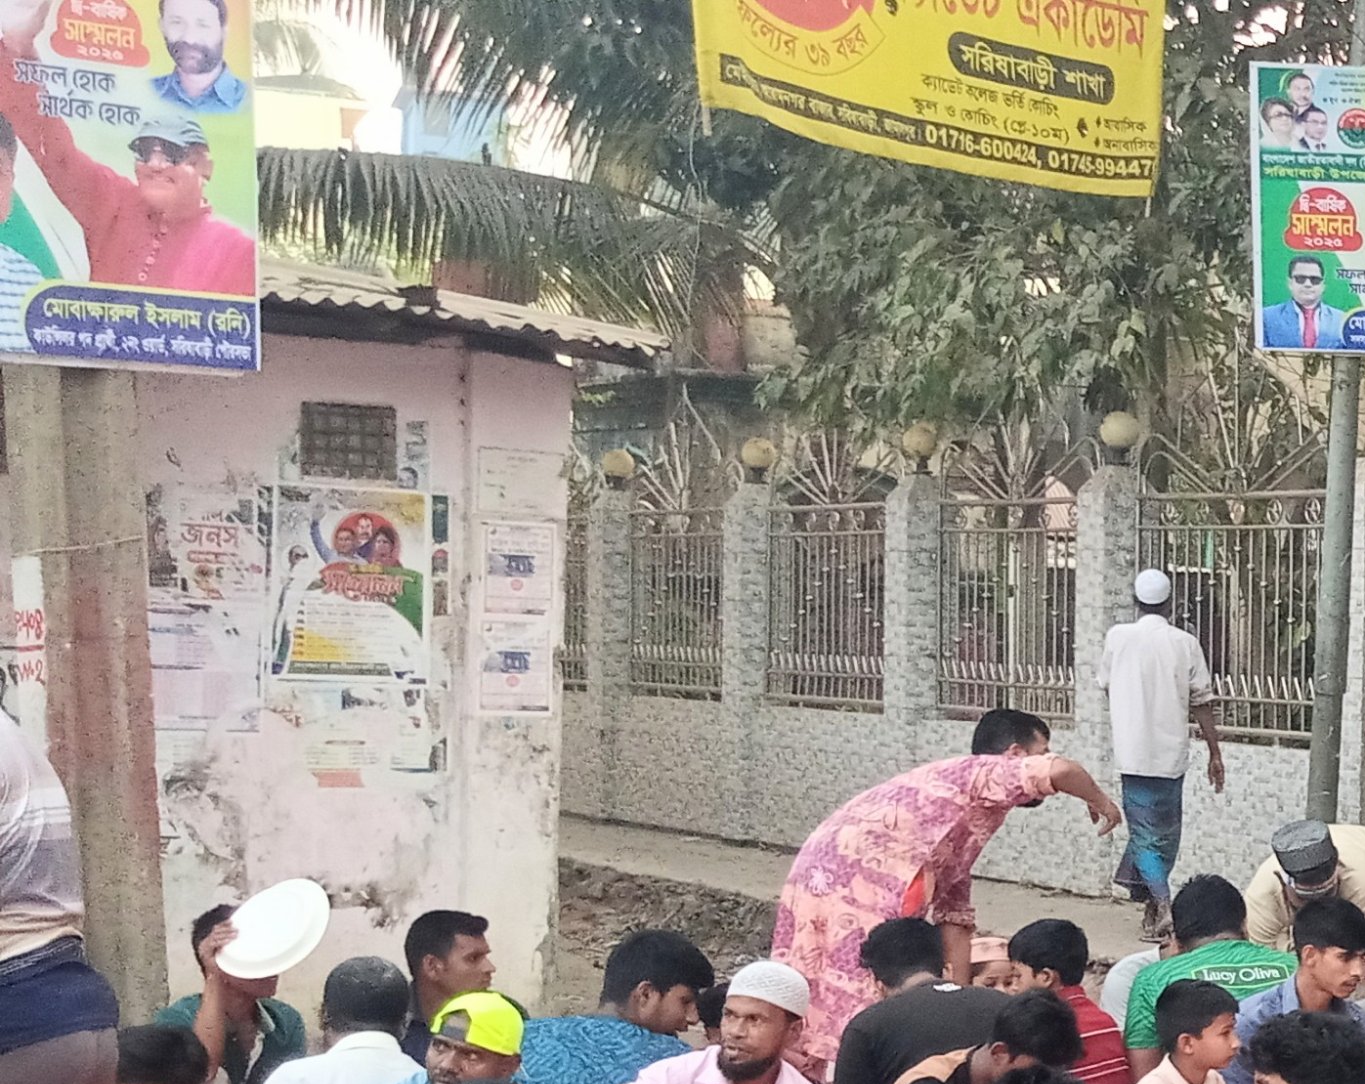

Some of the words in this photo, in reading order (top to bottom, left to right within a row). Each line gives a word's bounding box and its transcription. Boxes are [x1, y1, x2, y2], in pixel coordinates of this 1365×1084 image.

[14, 60, 67, 87] সফল
[72, 69, 116, 93] হোক
[958, 41, 1059, 93] সরিষাবাড়ী
[1063, 67, 1106, 98] শাখা
[37, 88, 95, 119] সার্থক
[98, 102, 141, 126] হোক
[1291, 213, 1355, 238] সম্মেলন
[143, 299, 202, 330] ইসলাম
[1202, 969, 1236, 985] Lucy
